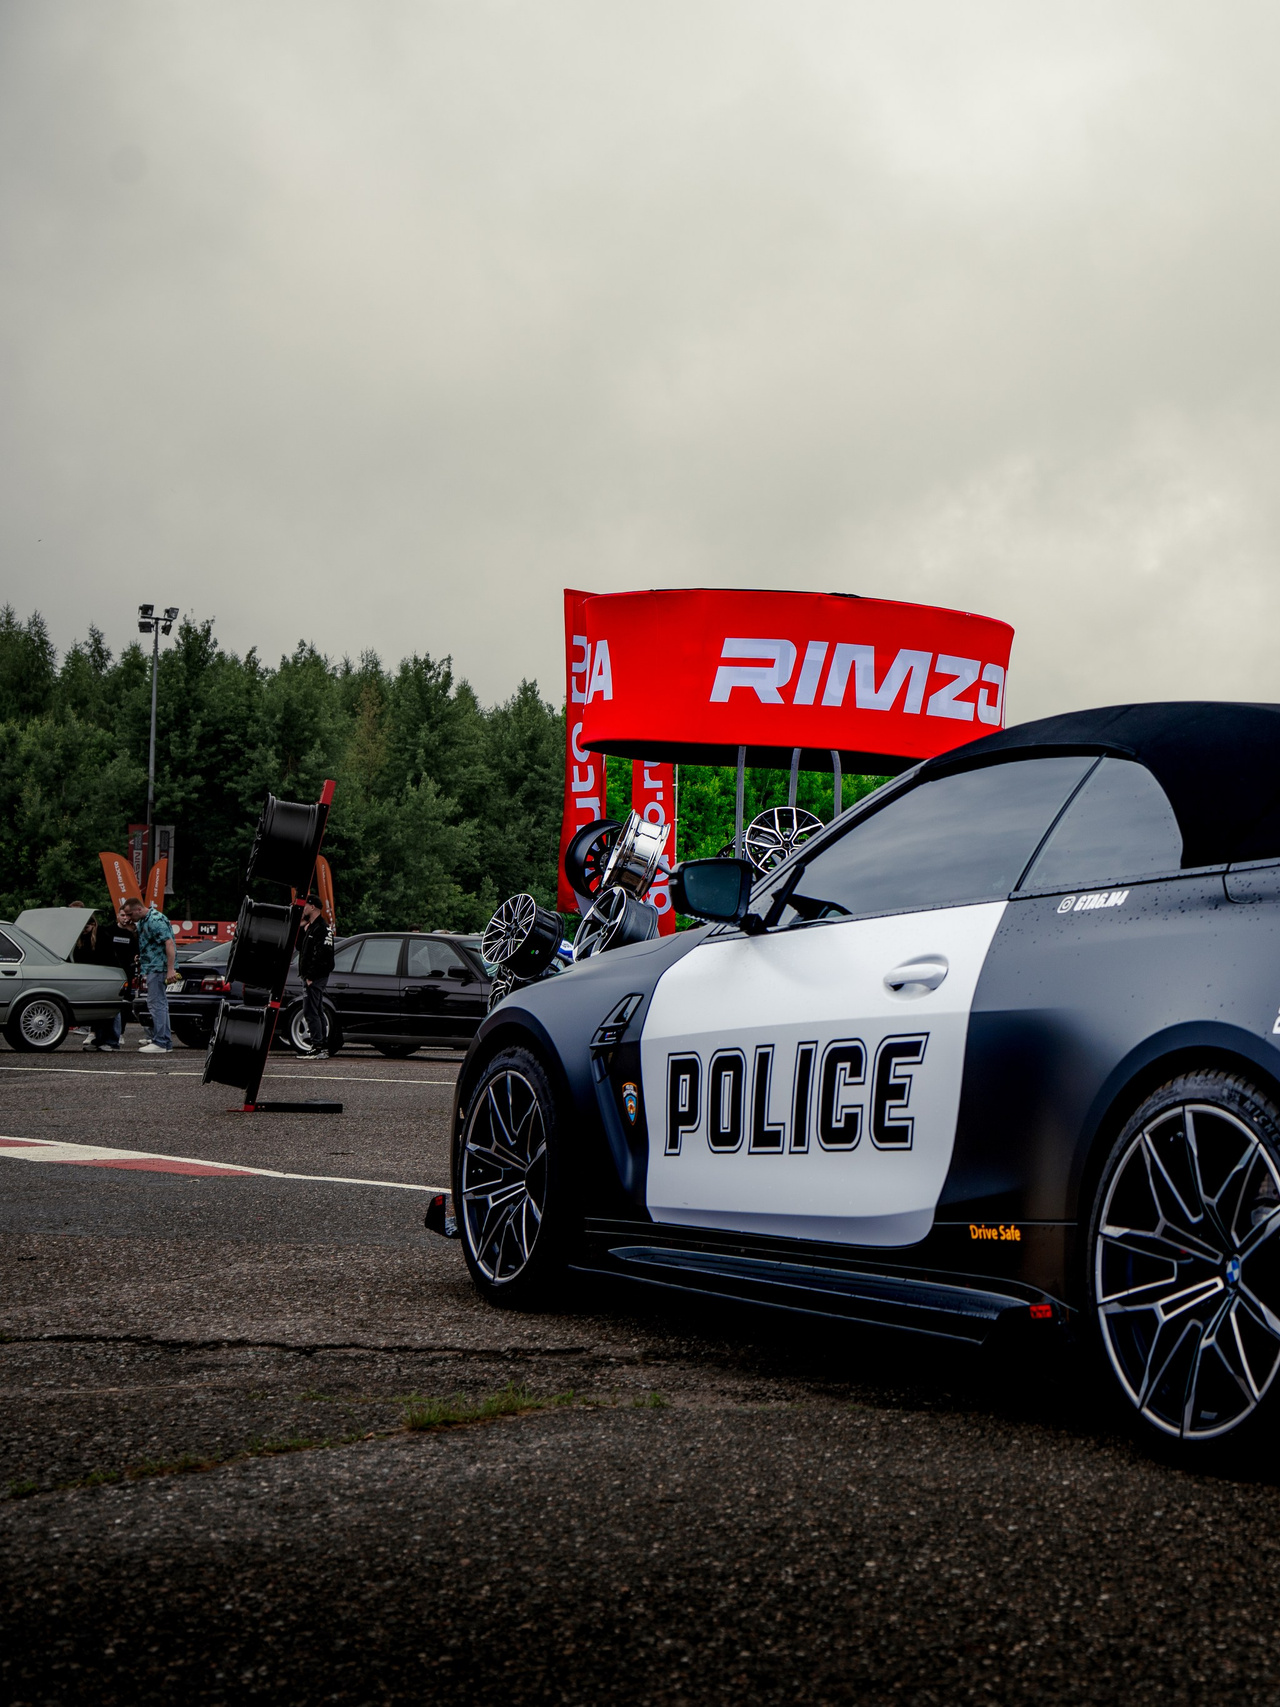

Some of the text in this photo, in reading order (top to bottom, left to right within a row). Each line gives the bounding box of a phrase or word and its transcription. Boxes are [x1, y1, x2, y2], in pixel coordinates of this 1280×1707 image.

[709, 637, 1005, 728] RIMZO
[664, 1032, 930, 1156] POLICE
[969, 1224, 1021, 1241] Drive Safe
